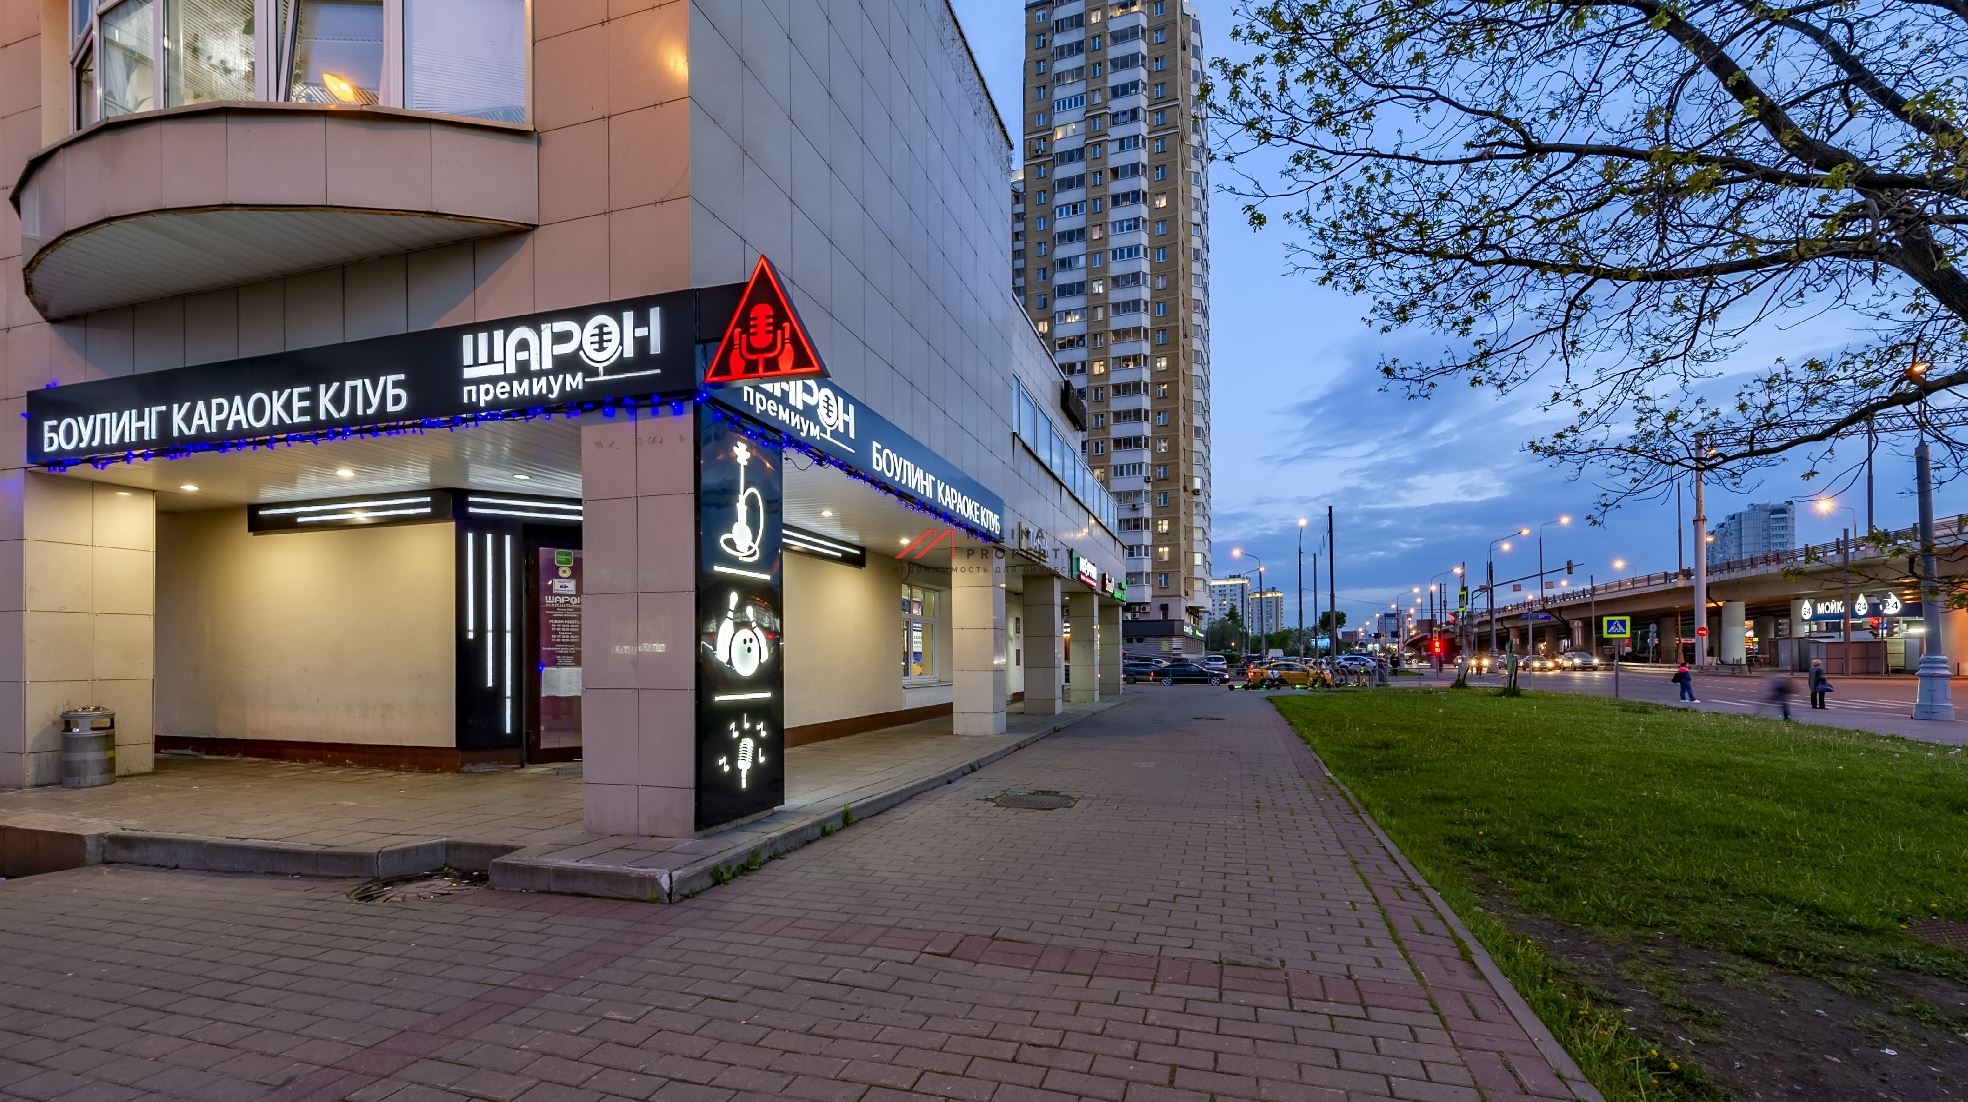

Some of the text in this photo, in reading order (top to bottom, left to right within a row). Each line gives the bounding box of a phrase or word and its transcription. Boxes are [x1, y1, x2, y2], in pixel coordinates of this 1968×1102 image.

[463, 307, 660, 378] ШАРОН
[43, 374, 407, 452] БОУЛИНГ КАРАОКЕ КЛУБ
[463, 372, 584, 407] премиум
[743, 385, 820, 440] премиум
[759, 379, 855, 439] АРОН
[872, 440, 1001, 535] БОУЛИНГ КАРАОКЕ КЛУБ
